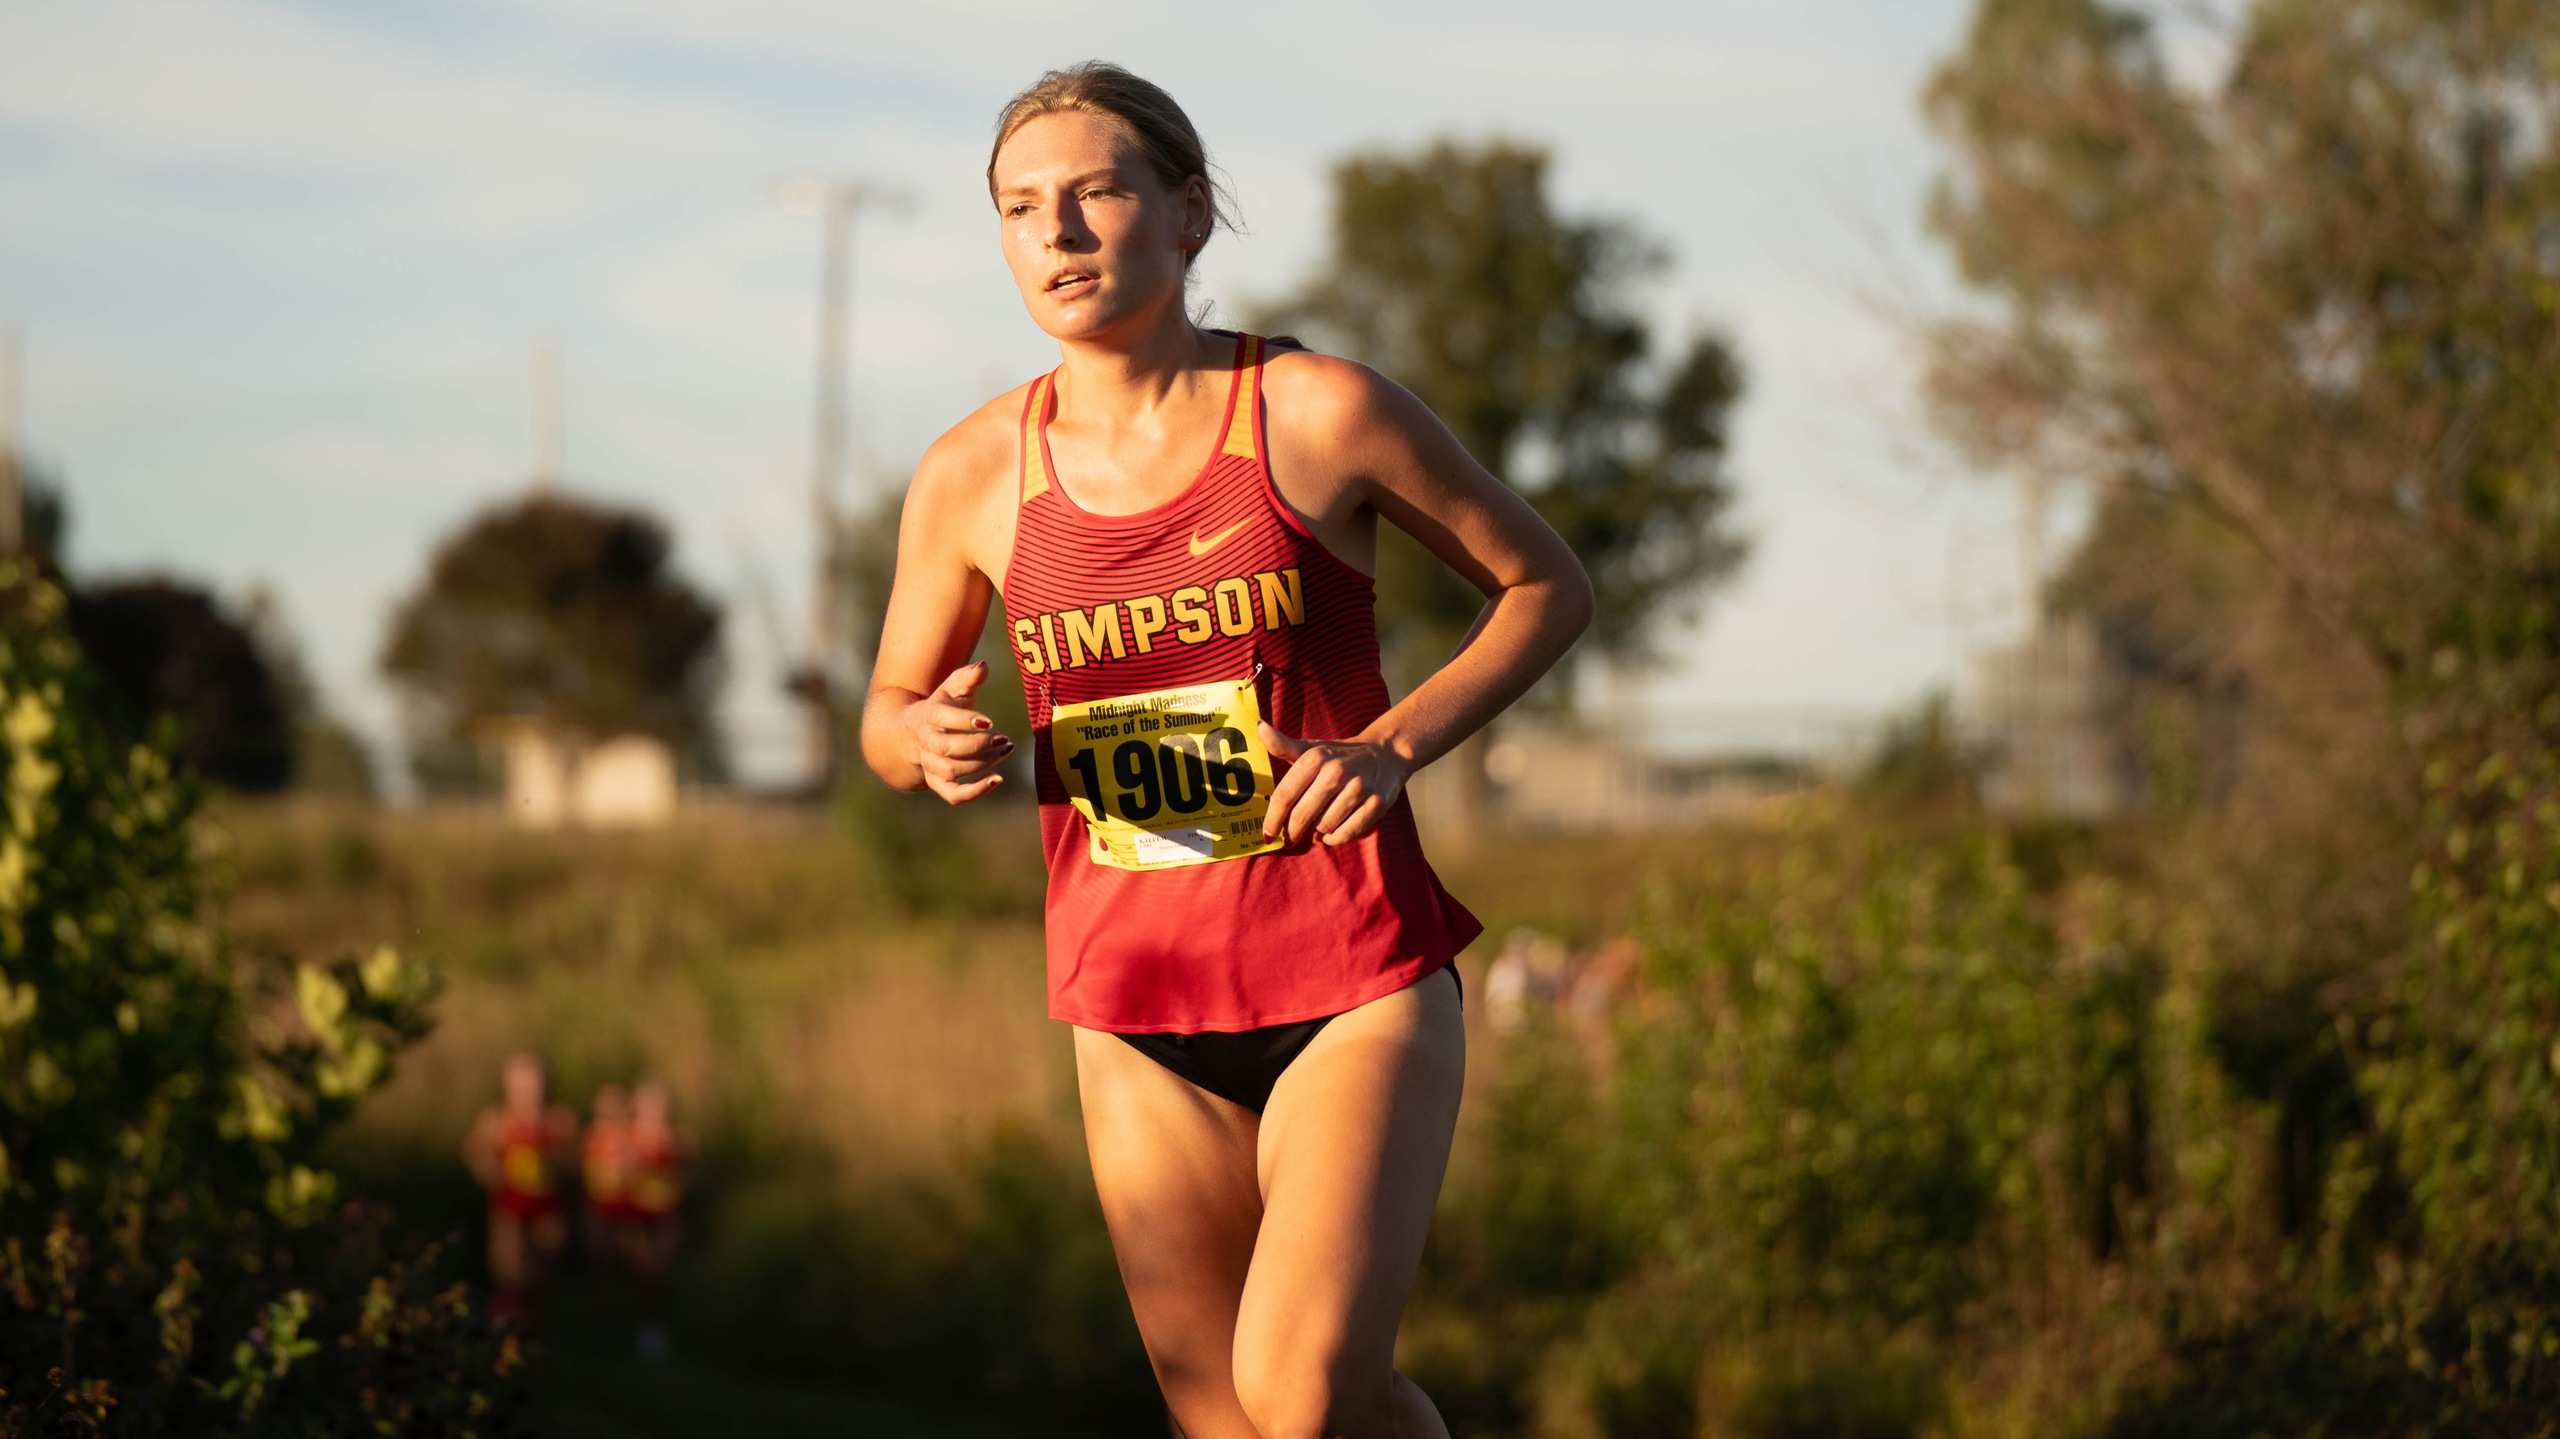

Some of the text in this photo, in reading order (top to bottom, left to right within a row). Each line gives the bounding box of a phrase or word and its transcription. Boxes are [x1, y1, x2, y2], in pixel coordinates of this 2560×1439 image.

[1014, 568, 1307, 675] SIMPSON
[1076, 705, 1222, 741] "Race of the Summer"
[1088, 692, 1208, 722] Midnight Madness
[1069, 727, 1254, 822] 1906
